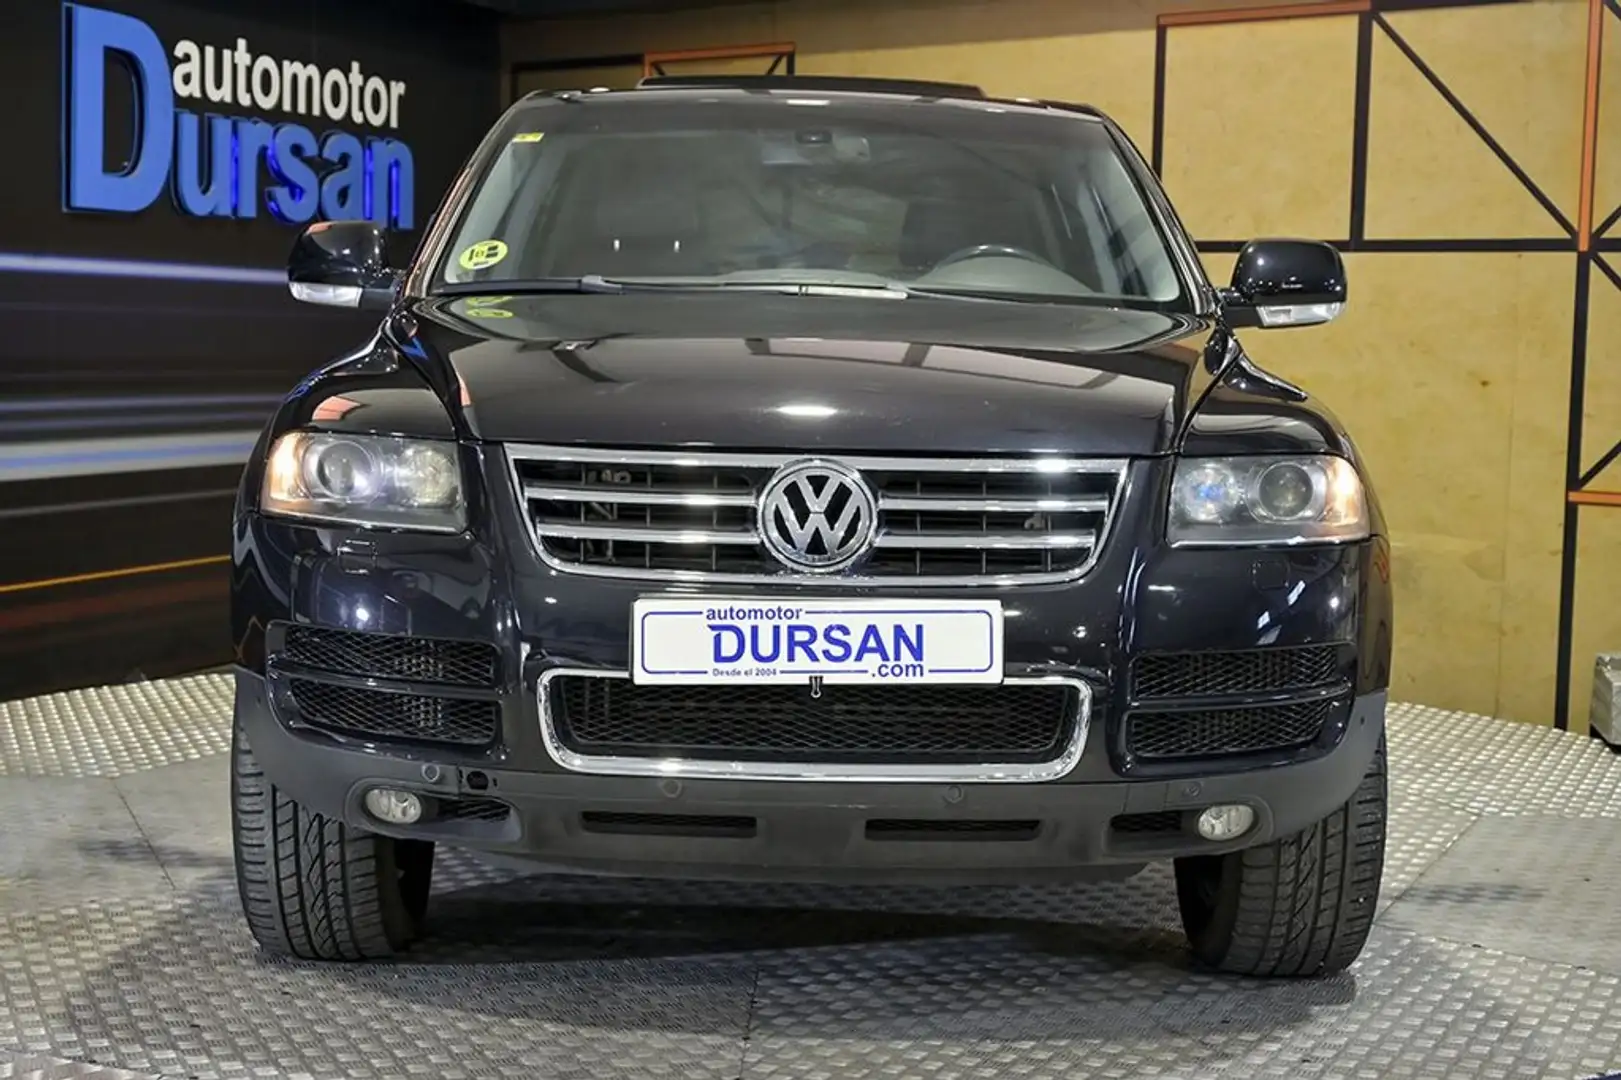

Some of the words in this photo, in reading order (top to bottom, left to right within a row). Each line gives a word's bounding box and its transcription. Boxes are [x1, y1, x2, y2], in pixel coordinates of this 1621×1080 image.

[173, 38, 406, 129] automotor
[63, 2, 414, 230] Dursan
[767, 468, 868, 563] VW
[706, 605, 803, 621] automotor
[707, 623, 925, 664] DURSAN
[712, 667, 742, 677] Desde
[871, 663, 925, 678] .com
